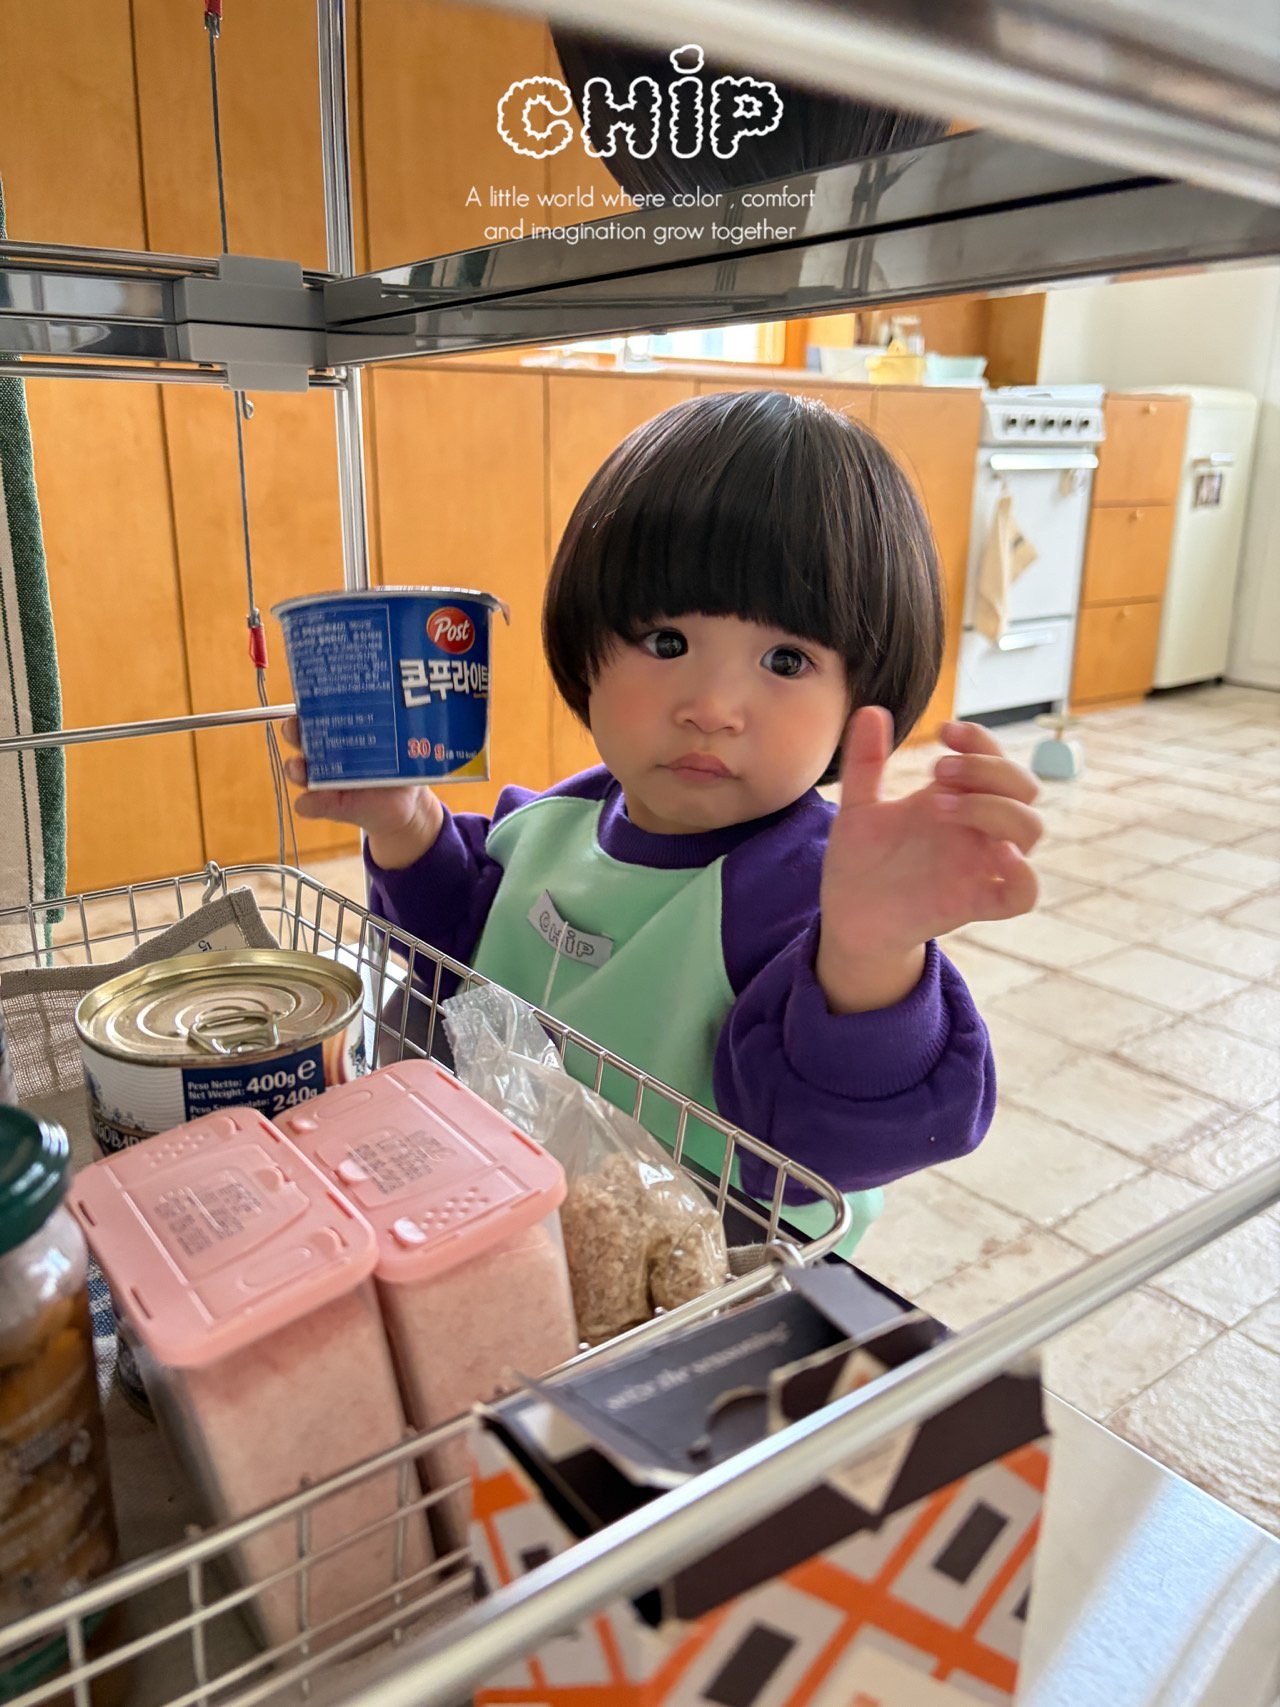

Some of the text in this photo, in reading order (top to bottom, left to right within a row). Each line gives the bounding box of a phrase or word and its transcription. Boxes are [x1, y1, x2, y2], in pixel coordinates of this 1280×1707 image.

[433, 616, 470, 643] Post
[400, 658, 490, 709] 콘푸라이트
[187, 1081, 209, 1091] Peso
[211, 1079, 243, 1089] Netto:
[246, 1071, 296, 1094] 400g
[188, 1087, 246, 1100] Net Weight:
